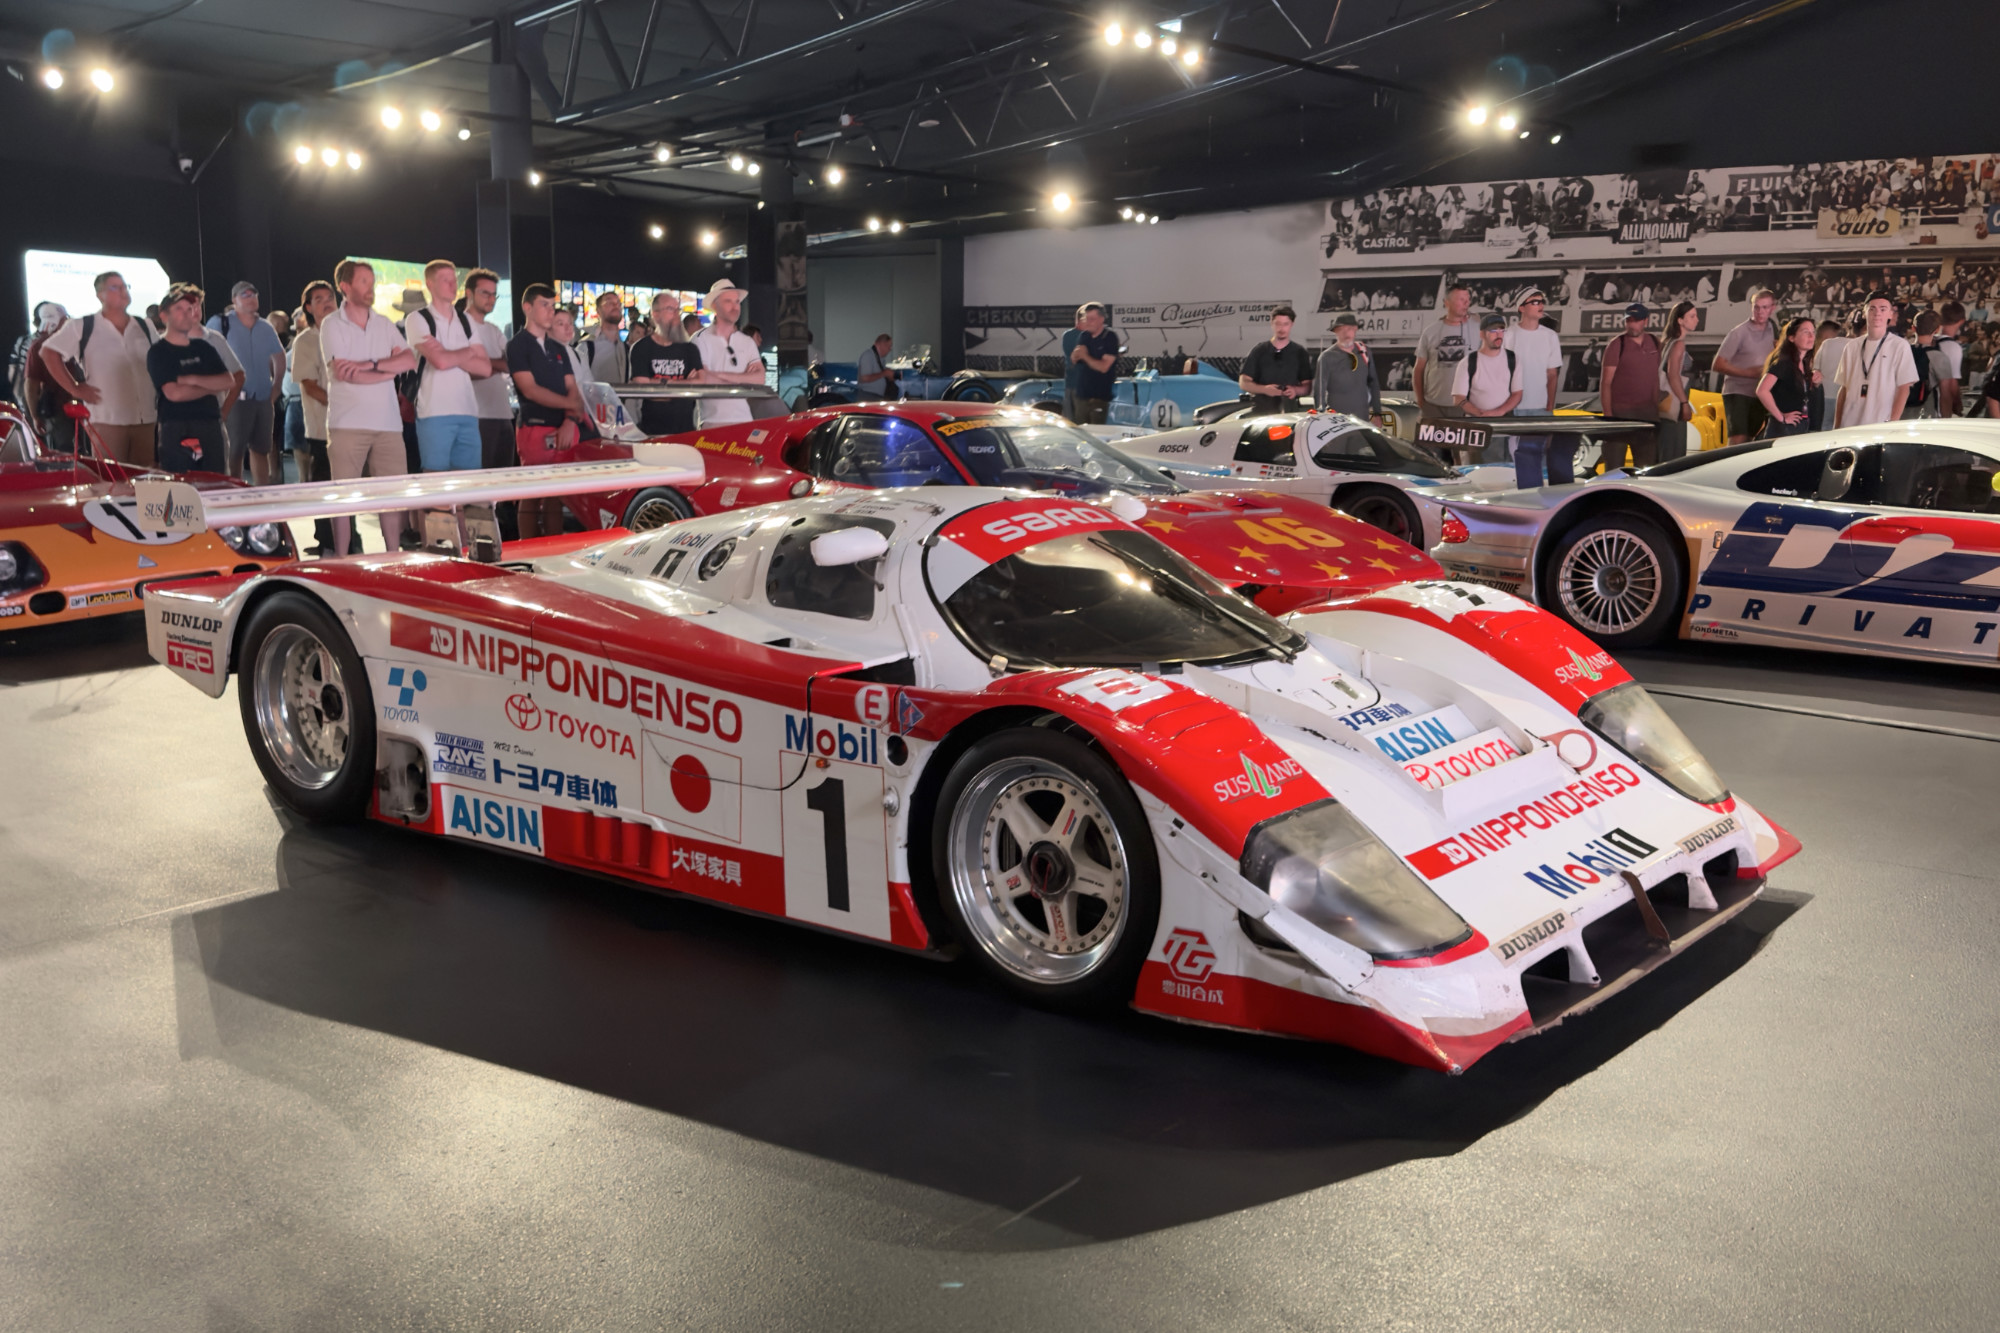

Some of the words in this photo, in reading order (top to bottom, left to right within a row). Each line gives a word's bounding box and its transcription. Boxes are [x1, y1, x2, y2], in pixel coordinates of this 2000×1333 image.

[1362, 236, 1411, 249] CASTROL
[1619, 221, 1690, 241] ALLINQUANT
[1837, 216, 1890, 235] auto
[1160, 303, 1235, 324] Brampton
[597, 403, 625, 426] USA
[1158, 444, 1189, 453] BOSCH
[1419, 424, 1466, 445] Mobil
[669, 531, 713, 548] Mobil
[1233, 517, 1345, 550] 46
[161, 610, 223, 633] DUNLOP
[462, 629, 742, 743] NIPPONDENSO
[383, 706, 420, 725] TOYOTA
[865, 689, 883, 721] E
[545, 709, 636, 760] TOYOTA
[785, 713, 878, 765] Mobil
[1374, 717, 1457, 762] AISIN
[434, 745, 486, 769] RAYS
[1434, 738, 1523, 782] TOYOTA
[493, 758, 618, 809] トヨタ車体
[451, 794, 541, 848] AISIN
[1458, 762, 1641, 857] NIPPONDENSO
[806, 777, 851, 913] 1
[1682, 818, 1735, 853] DUNLOP
[672, 847, 742, 888] 大塚家具
[1524, 838, 1637, 899] Mobil
[1498, 912, 1566, 960] DUNLOP
